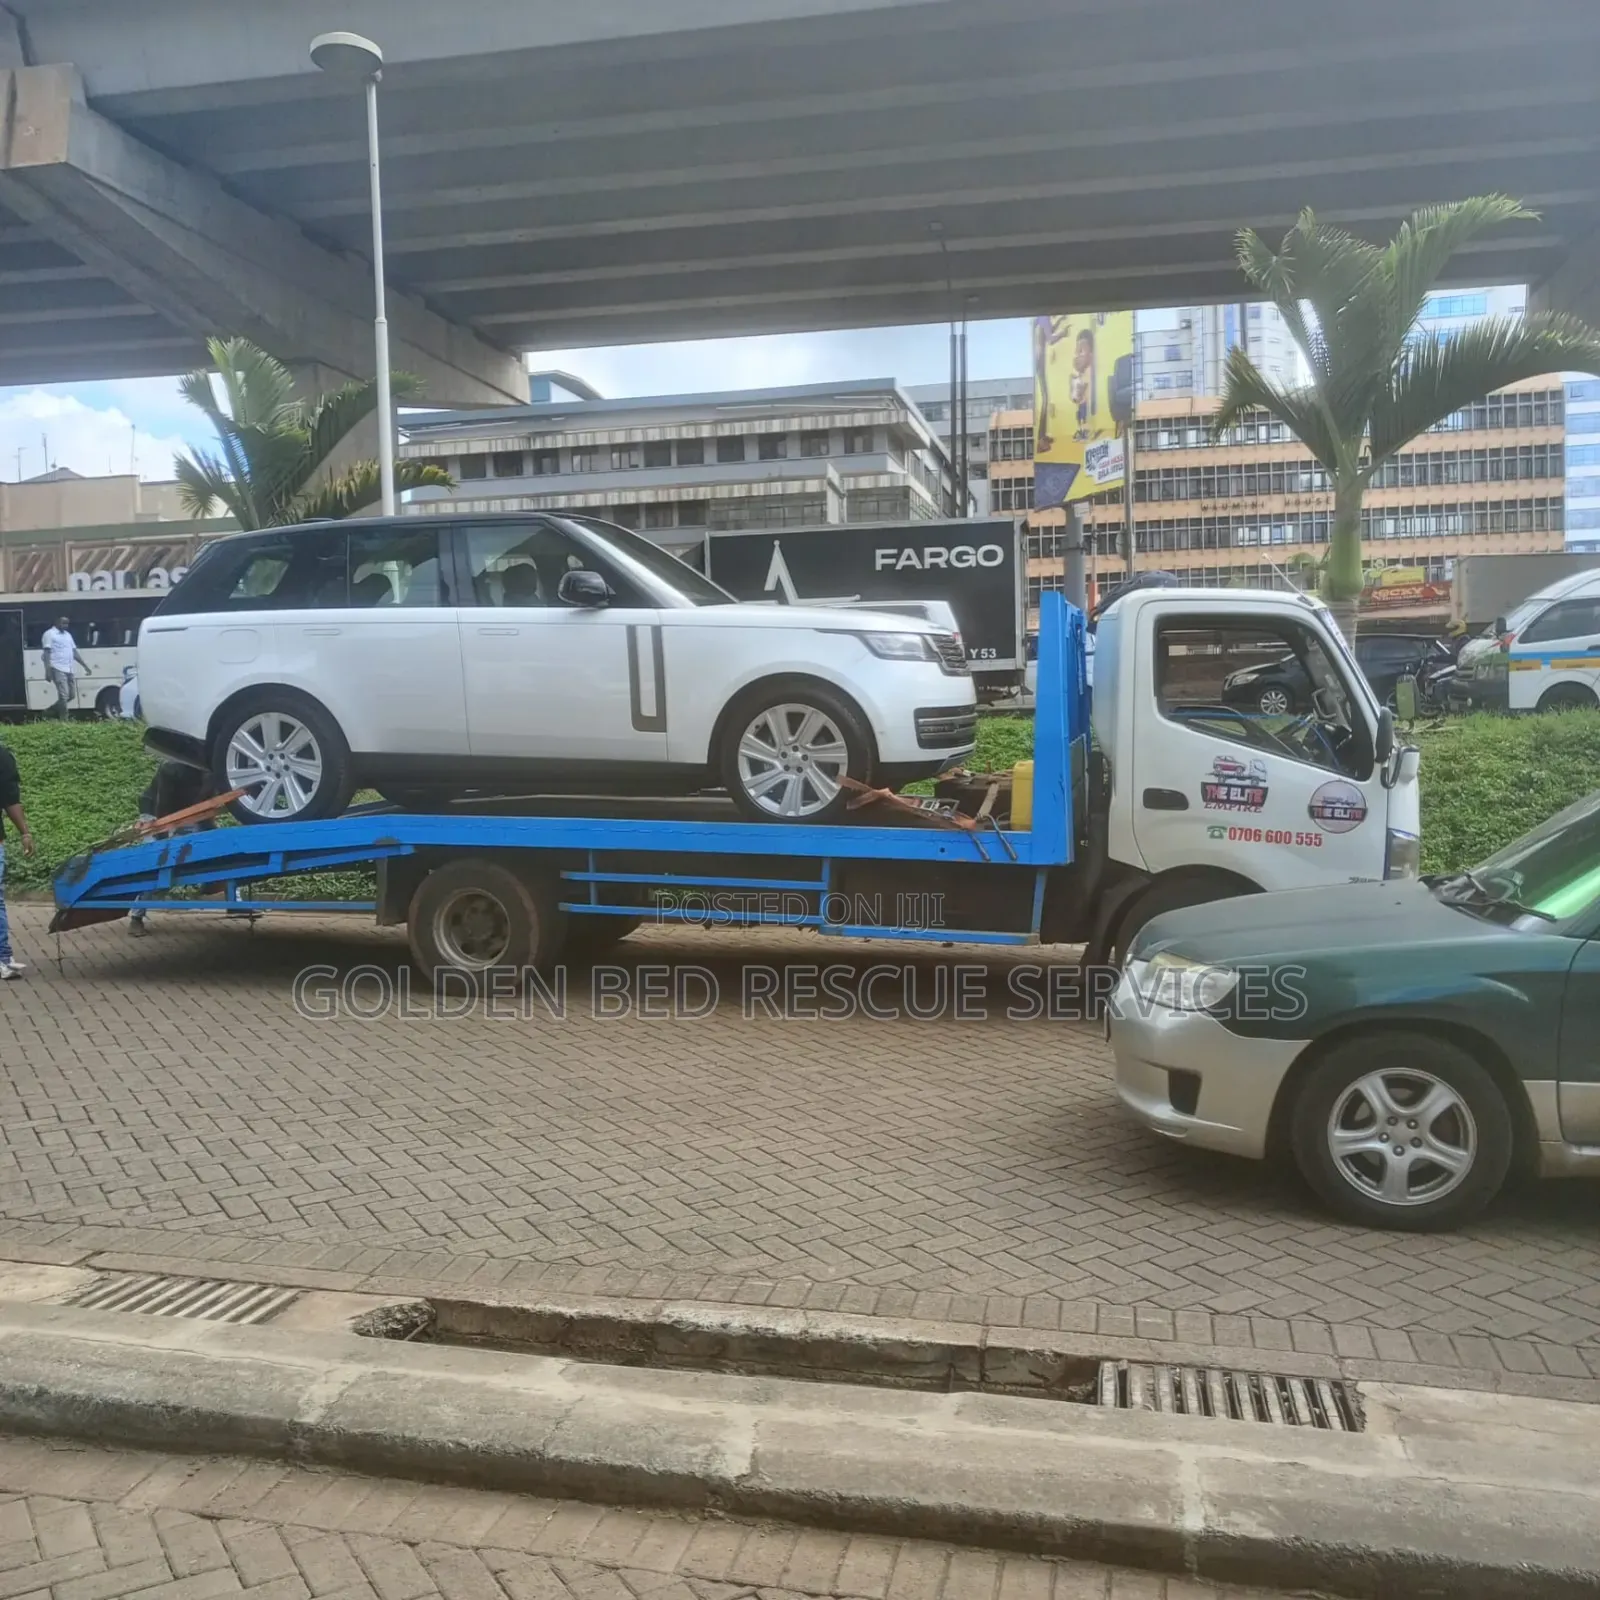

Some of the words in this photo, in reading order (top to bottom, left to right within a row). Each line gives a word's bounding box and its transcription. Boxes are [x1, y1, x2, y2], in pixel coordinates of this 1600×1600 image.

[1285, 496, 1332, 506] HOUSE
[875, 544, 1004, 571] FARGO
[1206, 784, 1228, 800] THE
[1230, 786, 1264, 803] ELITE
[1203, 802, 1263, 814] EMPIRE
[1313, 807, 1332, 817] THE
[1334, 808, 1364, 819] ELITE
[1228, 827, 1261, 842] 0706
[1265, 829, 1292, 845] 600
[1296, 832, 1323, 847] 555
